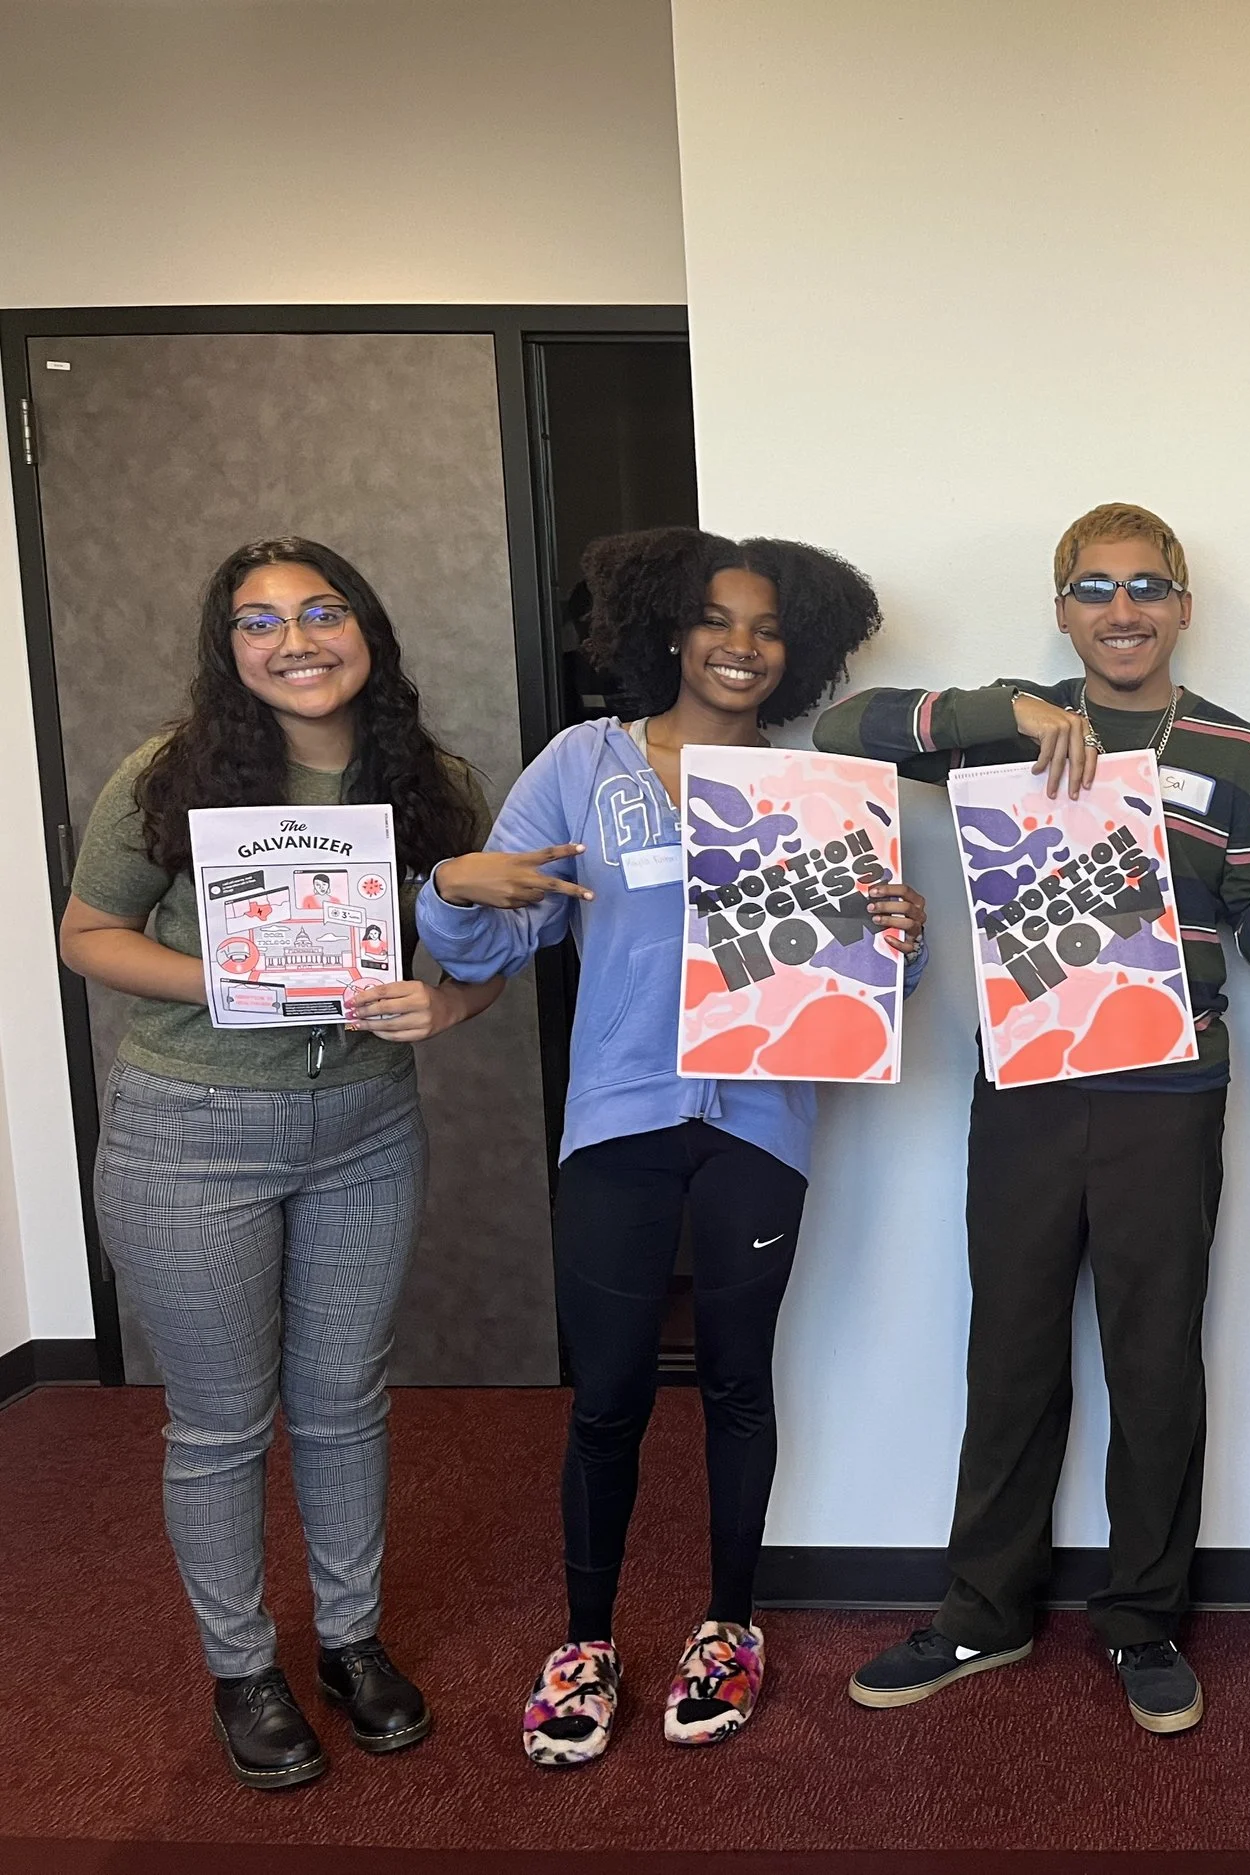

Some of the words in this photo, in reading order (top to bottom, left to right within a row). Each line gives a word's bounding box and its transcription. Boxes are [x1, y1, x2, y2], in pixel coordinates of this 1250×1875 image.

[280, 820, 307, 832] The
[1163, 776, 1185, 791] Sal
[237, 836, 353, 859] GALVANIZER
[707, 853, 885, 949] ACCESS
[711, 889, 891, 993] NOW
[996, 848, 1151, 965] ACCESS
[1005, 867, 1166, 1003] NOW
